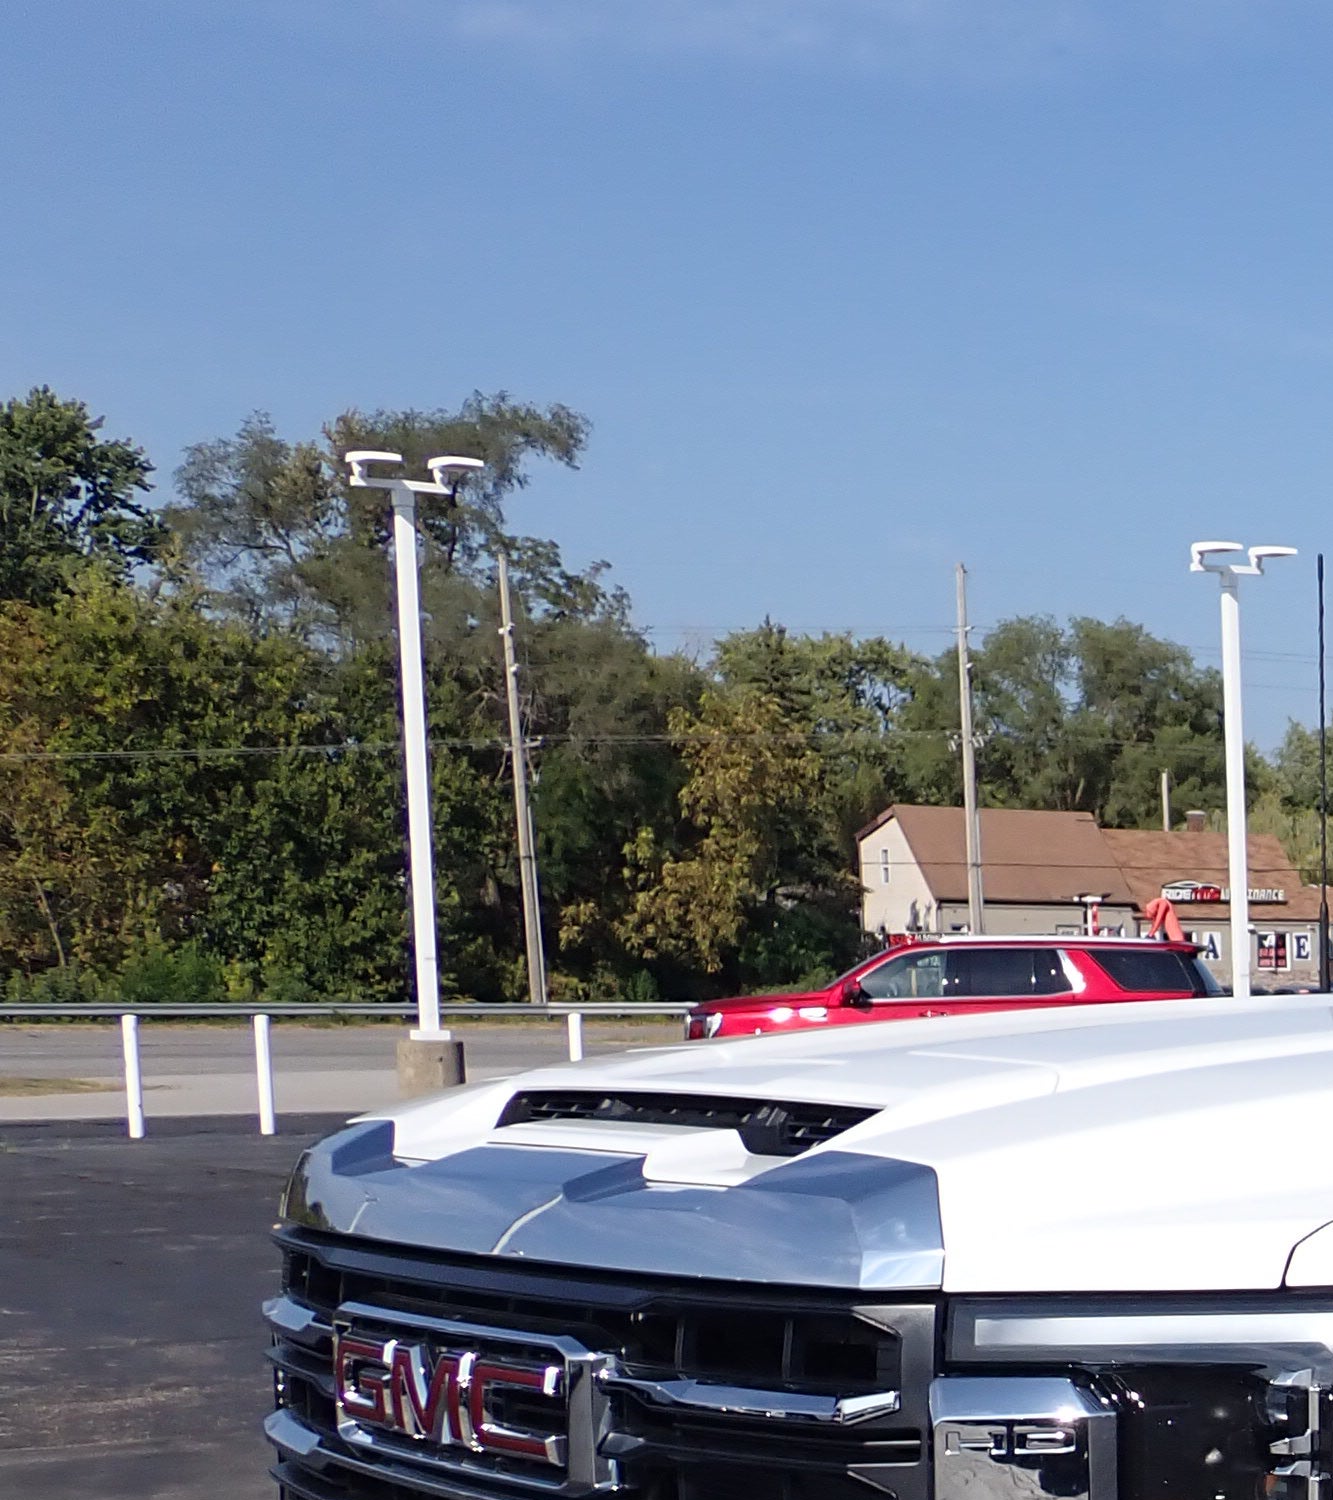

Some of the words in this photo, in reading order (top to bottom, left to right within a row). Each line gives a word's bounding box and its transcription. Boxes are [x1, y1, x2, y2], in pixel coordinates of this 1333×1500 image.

[1248, 888, 1285, 901] INANCE
[336, 1333, 567, 1467] GMC
[945, 1425, 1076, 1456] HD
